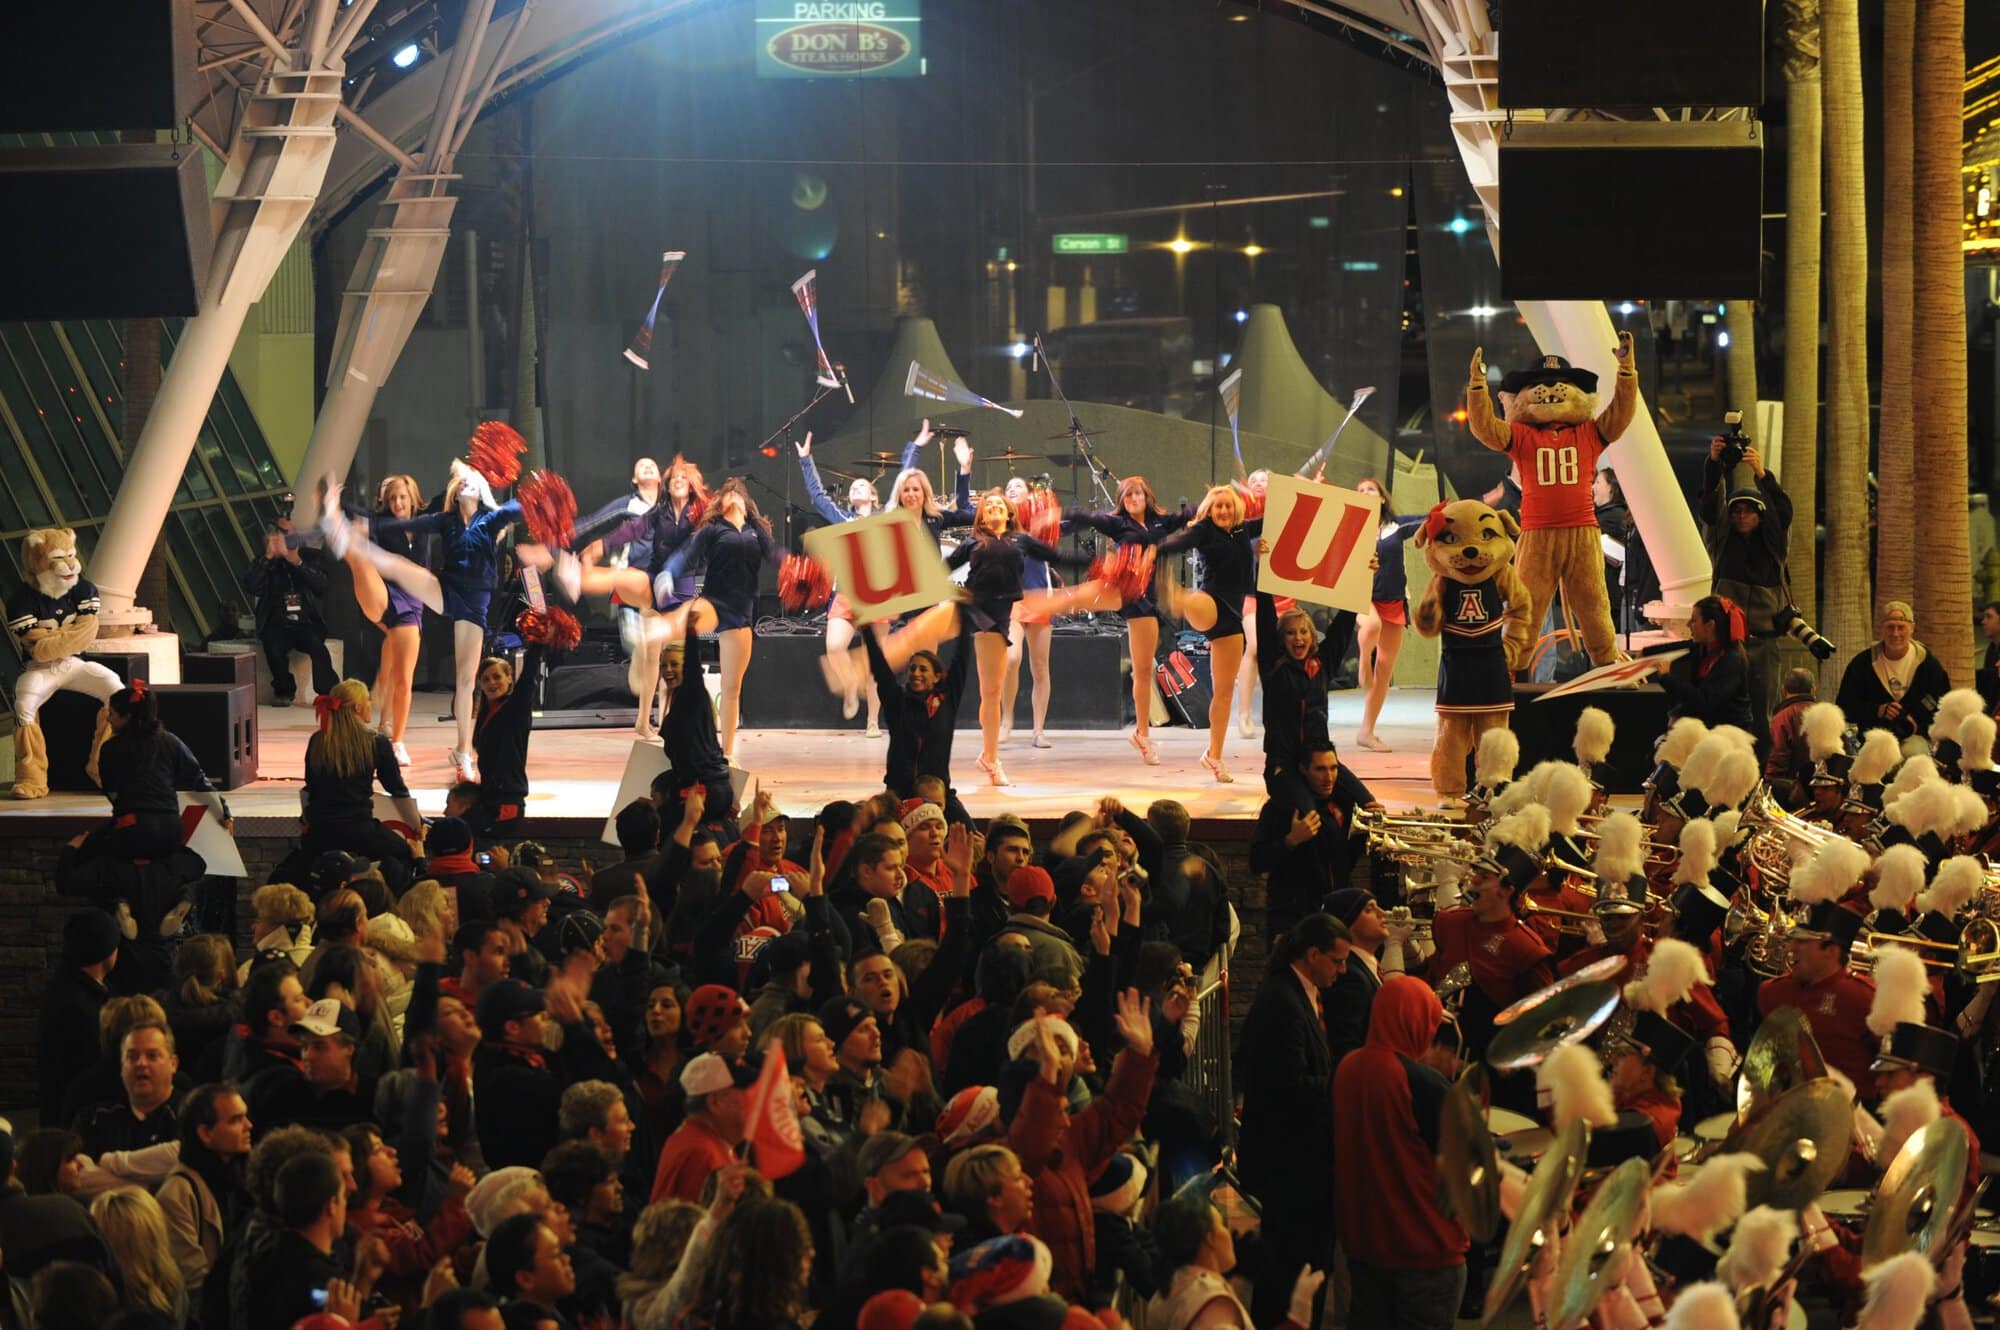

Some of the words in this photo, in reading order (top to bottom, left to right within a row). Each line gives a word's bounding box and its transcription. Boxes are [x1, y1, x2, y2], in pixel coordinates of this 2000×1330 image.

[795, 2, 885, 18] PARKING
[791, 33, 848, 51] DON
[791, 52, 887, 63] STEAKHOUSE
[1536, 446, 1579, 486] 08
[1456, 589, 1489, 624] A
